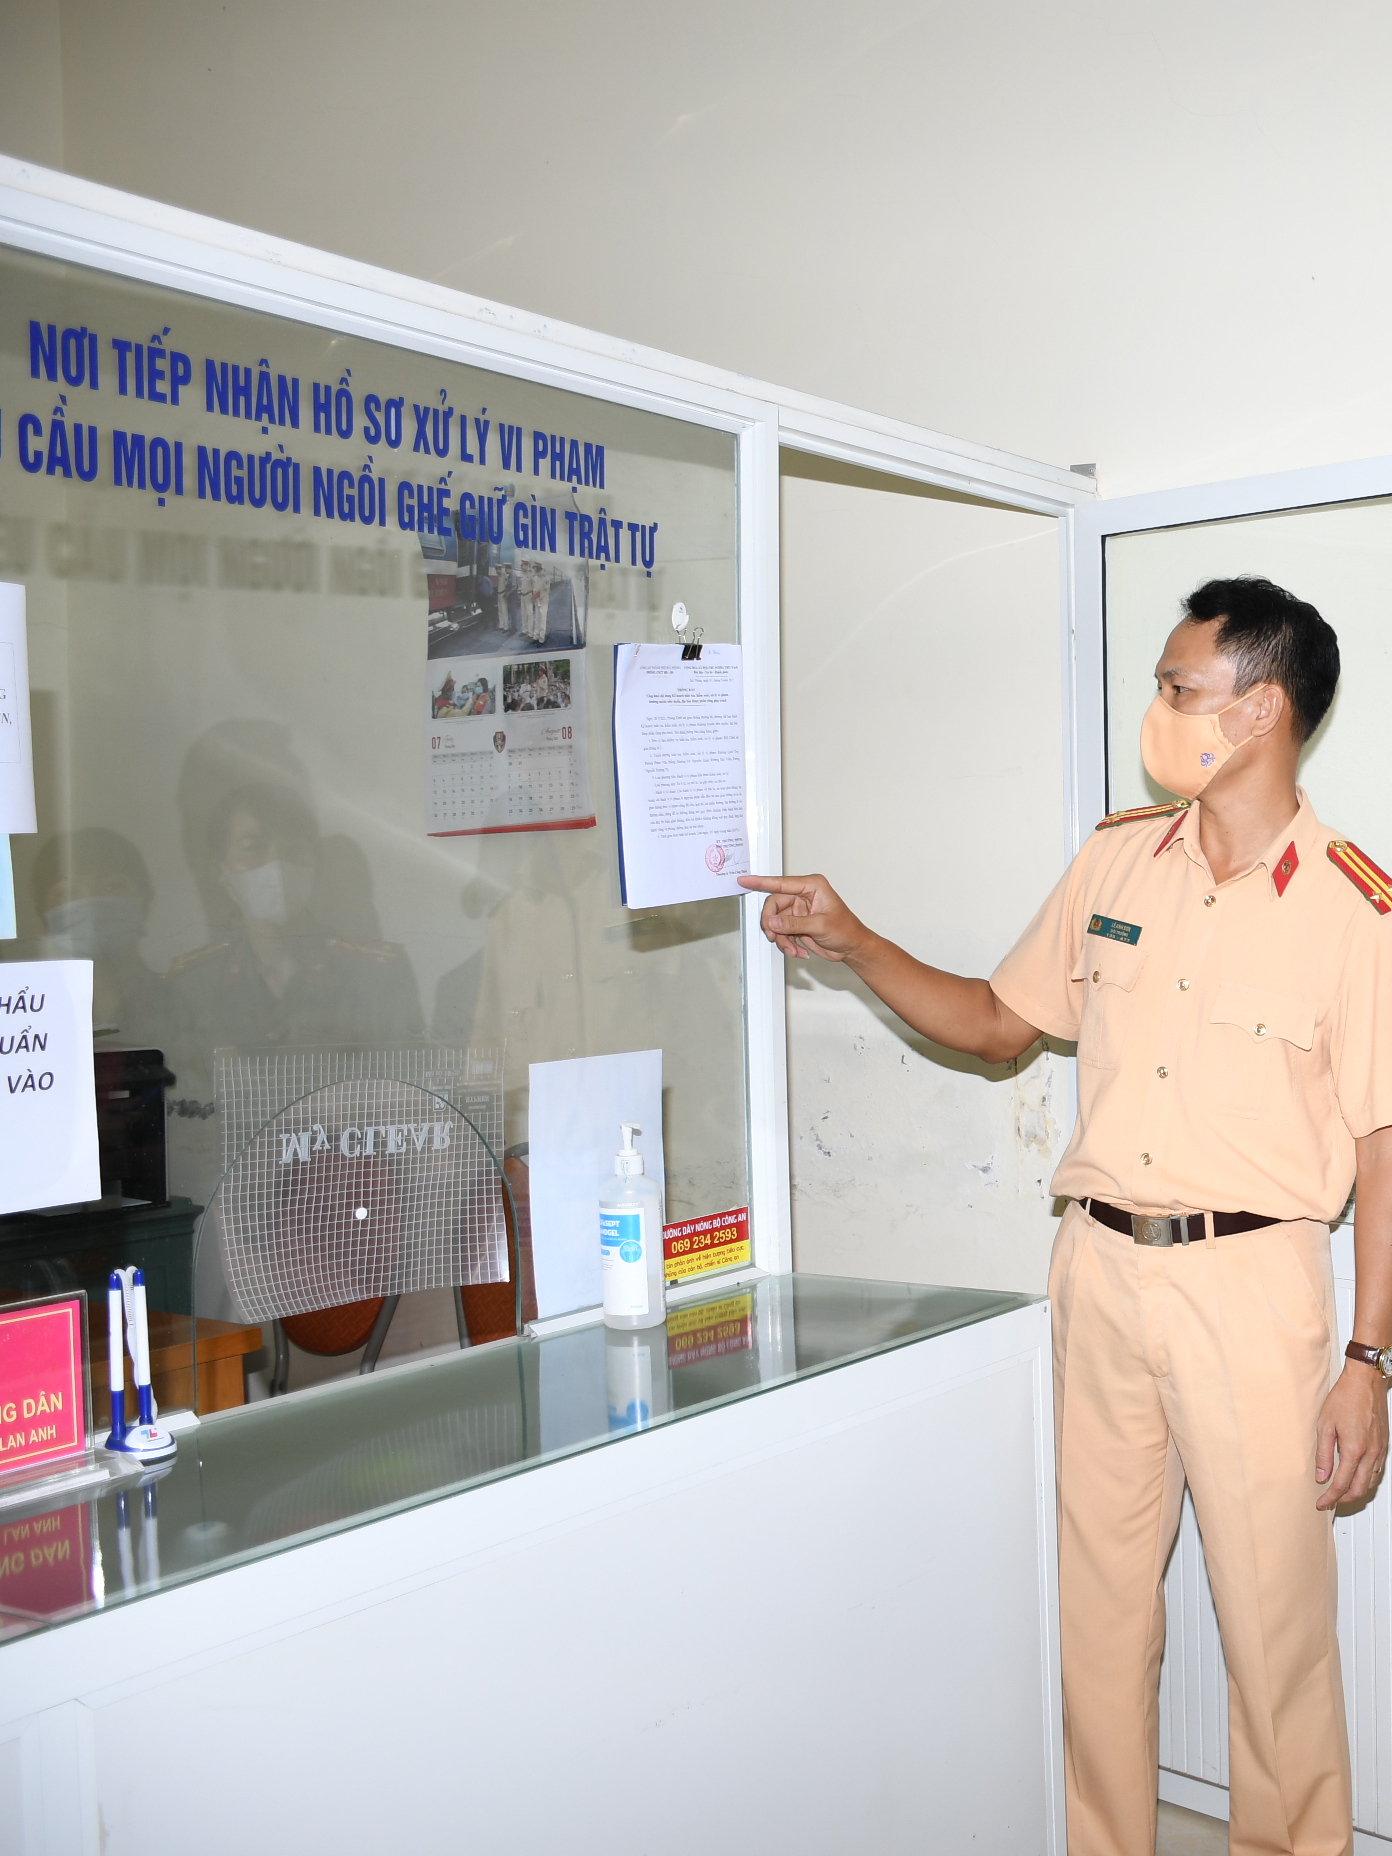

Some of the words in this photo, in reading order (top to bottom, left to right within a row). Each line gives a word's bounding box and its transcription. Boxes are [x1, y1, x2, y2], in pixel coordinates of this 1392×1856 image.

[29, 320, 99, 391] NƠI
[112, 327, 192, 407] TIẾP
[205, 358, 300, 435] NHẬN
[313, 368, 354, 440] HỒ
[363, 394, 404, 449] SƠ
[413, 388, 454, 458] XỬ
[460, 407, 490, 466] LÝ
[499, 423, 523, 473] VI
[533, 430, 605, 493] PHẠM
[18, 393, 98, 482] CẦU
[113, 429, 184, 507] MỌI
[198, 443, 301, 514] NGƯỜI
[313, 455, 386, 527] NGỒI
[398, 470, 454, 537] GHẾ
[459, 486, 508, 546] GIỮ
[514, 493, 557, 554] GÌN
[565, 507, 623, 571] TRẬT
[627, 522, 658, 578] TỰ
[431, 736, 441, 749] 07
[562, 726, 572, 739] 08
[7, 1068, 55, 1095] VÀO
[737, 1212, 747, 1222] AN
[671, 1238, 691, 1254] 069
[692, 1233, 711, 1249] 234
[713, 1227, 738, 1244] 2593
[23, 1390, 63, 1419] DÂN
[29, 1424, 57, 1445] ANH
